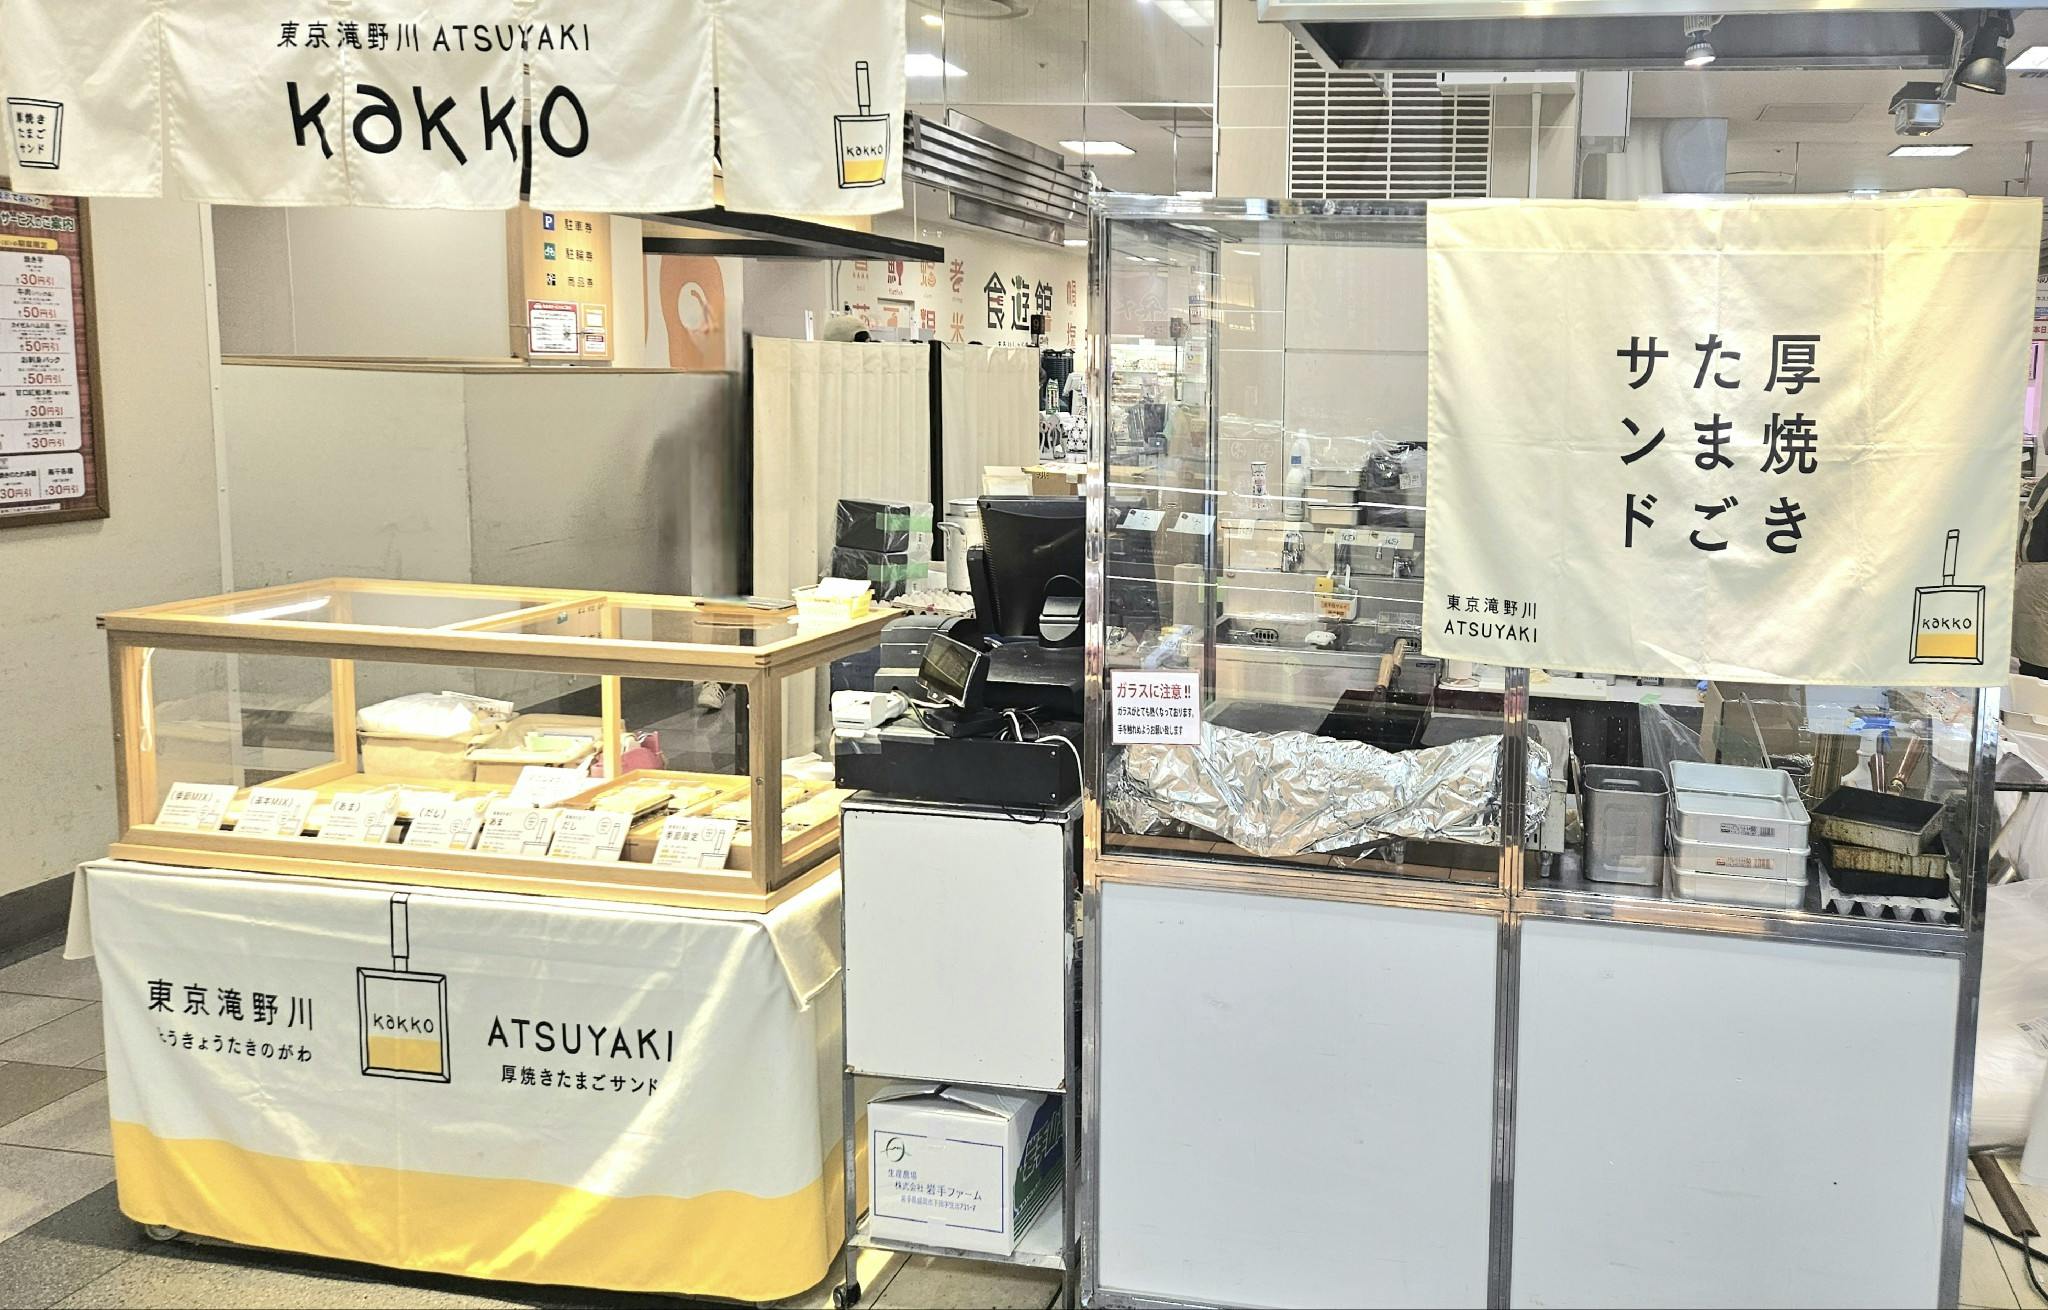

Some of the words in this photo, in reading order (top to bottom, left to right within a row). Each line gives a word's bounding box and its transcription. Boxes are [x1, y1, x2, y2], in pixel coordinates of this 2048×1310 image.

[277, 20, 419, 51] 東京滝野川
[432, 23, 590, 51] ATSUYAKI
[983, 271, 1053, 332] 食遊館
[1616, 336, 1669, 548] サンド
[1689, 333, 1742, 552] たまご
[1759, 334, 1821, 554] 厚焼き
[1444, 619, 1537, 643] ATSUYAKI
[1446, 594, 1537, 620] 東京滝野川
[147, 978, 314, 1031] 東京滝野川
[488, 1015, 673, 1063] ATSUYAKI
[501, 1064, 658, 1097] 厚焼きたまごサンド
